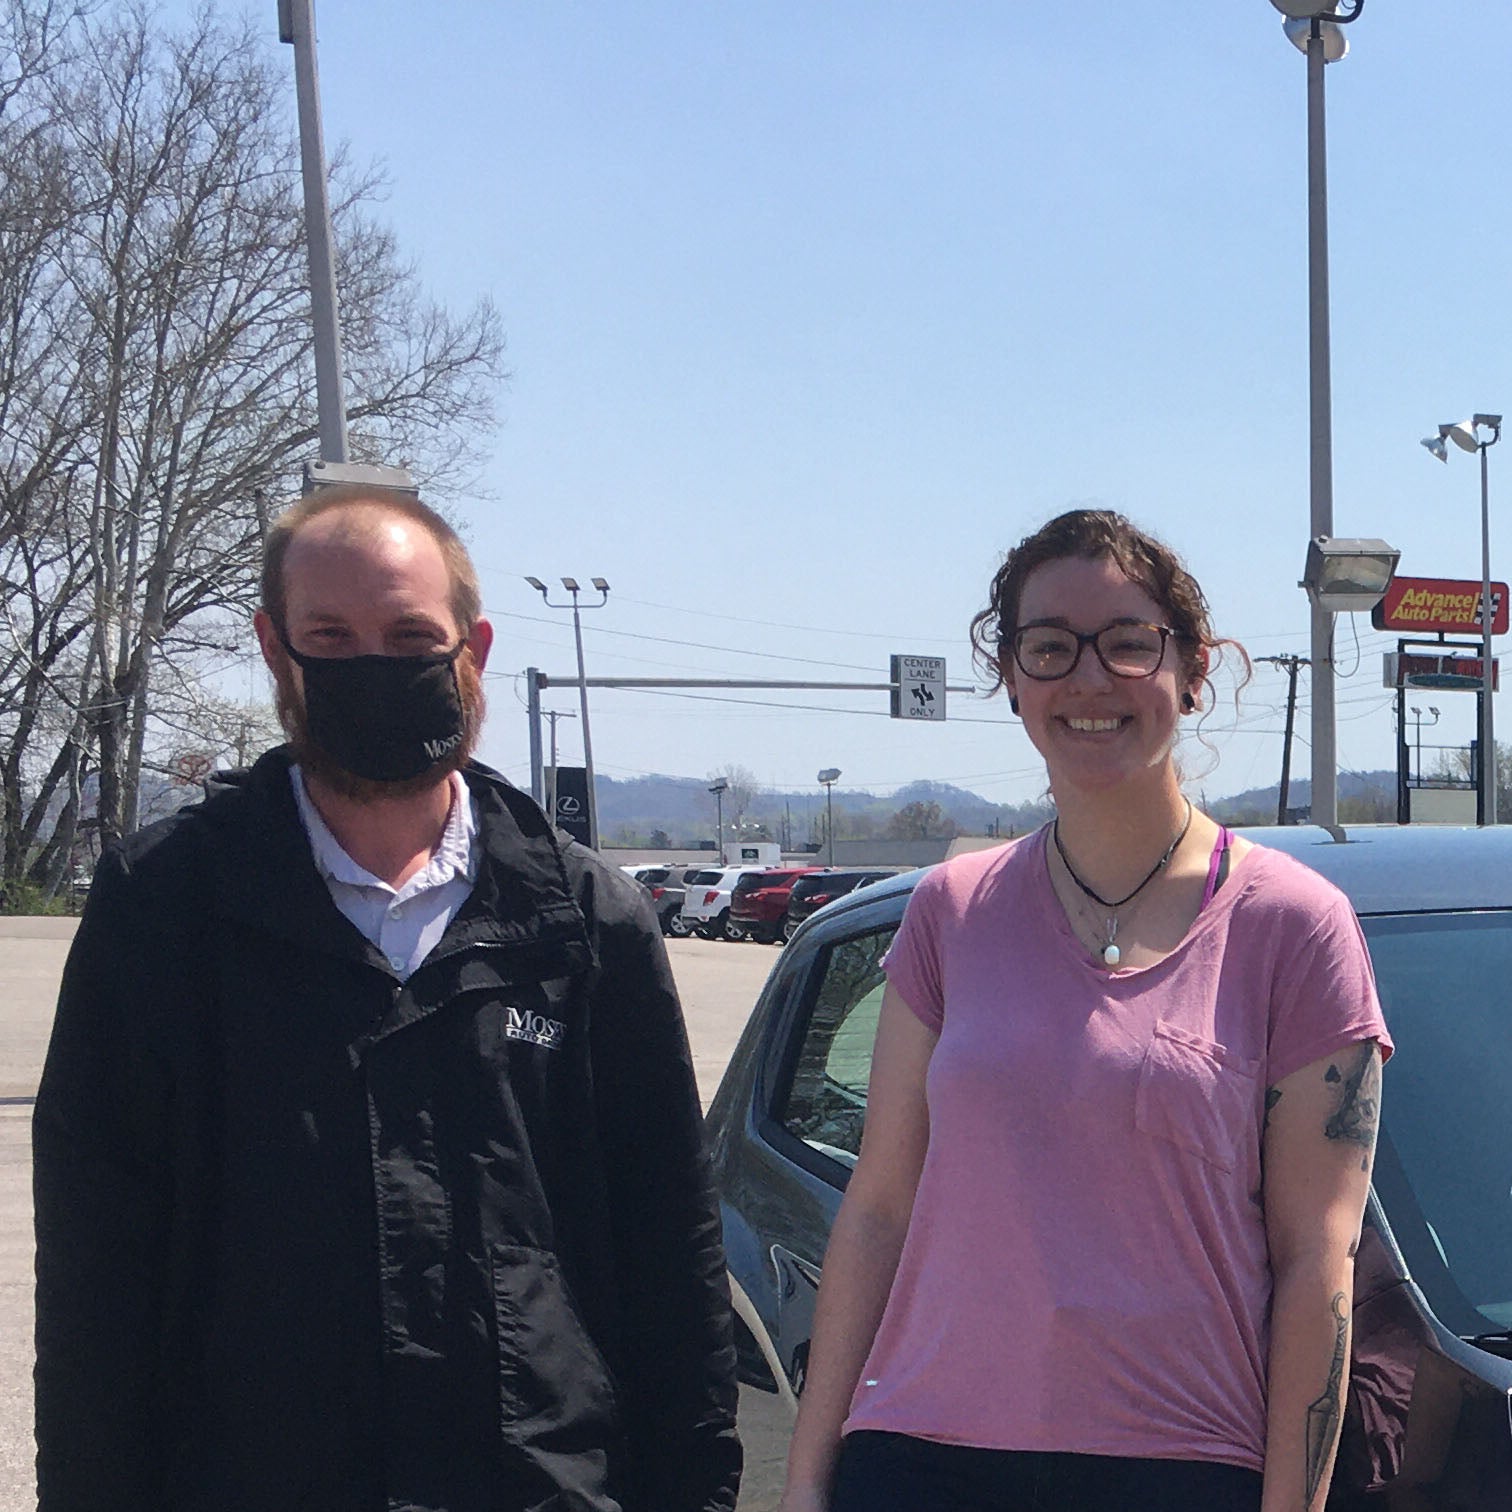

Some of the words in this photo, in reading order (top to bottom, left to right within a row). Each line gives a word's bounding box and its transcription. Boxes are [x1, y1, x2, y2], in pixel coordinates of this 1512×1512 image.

[1400, 588, 1473, 608] Advance
[1391, 605, 1429, 620] Auto
[1430, 607, 1470, 623] Parts
[904, 659, 941, 669] CENTER
[910, 670, 935, 680] LANE
[911, 708, 935, 718] ONLY
